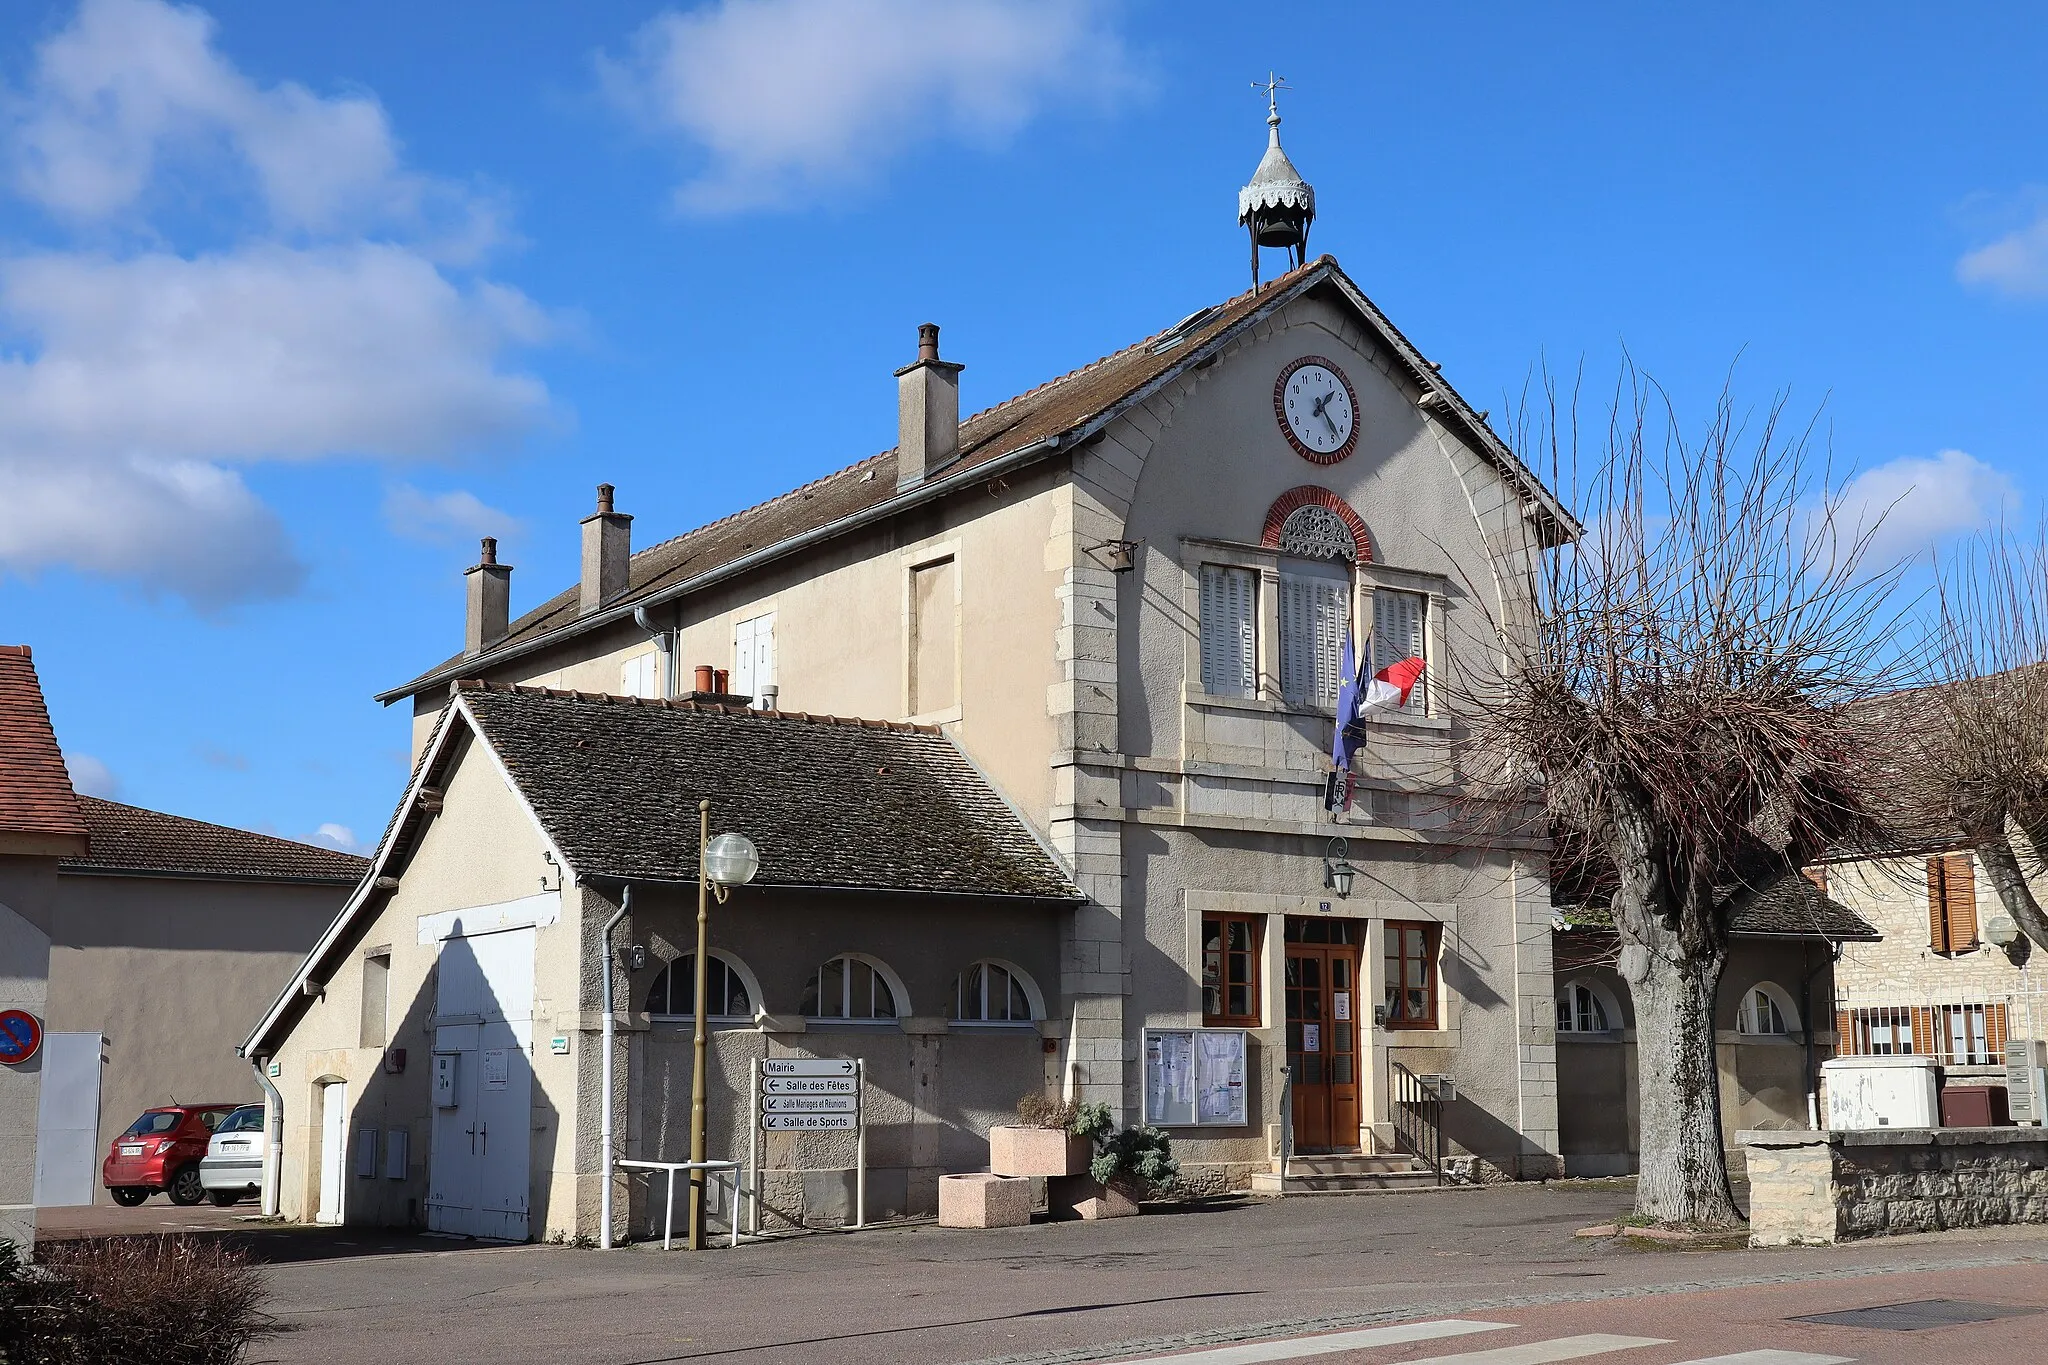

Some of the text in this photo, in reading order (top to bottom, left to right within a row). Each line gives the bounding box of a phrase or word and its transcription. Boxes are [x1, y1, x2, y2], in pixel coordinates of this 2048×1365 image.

[1302, 375, 1308, 384] 11
[1314, 372, 1322, 382] 12
[1328, 380, 1332, 388] 1
[1292, 385, 1300, 394] 10
[1338, 393, 1343, 402] 2
[1290, 400, 1294, 408] 9
[1344, 410, 1348, 418] 3
[1294, 416, 1300, 426] 8
[1340, 425, 1344, 434] 4
[1306, 430, 1310, 439] 7
[1318, 436, 1322, 446] 6
[1330, 435, 1335, 444] 5
[768, 1063, 795, 1072] Mairie
[786, 1080, 850, 1090] Salle des Fêtes
[783, 1099, 795, 1108] Salle
[796, 1098, 818, 1110] Mariages
[819, 1099, 824, 1108] et
[783, 1117, 848, 1128] Salle de Sports
